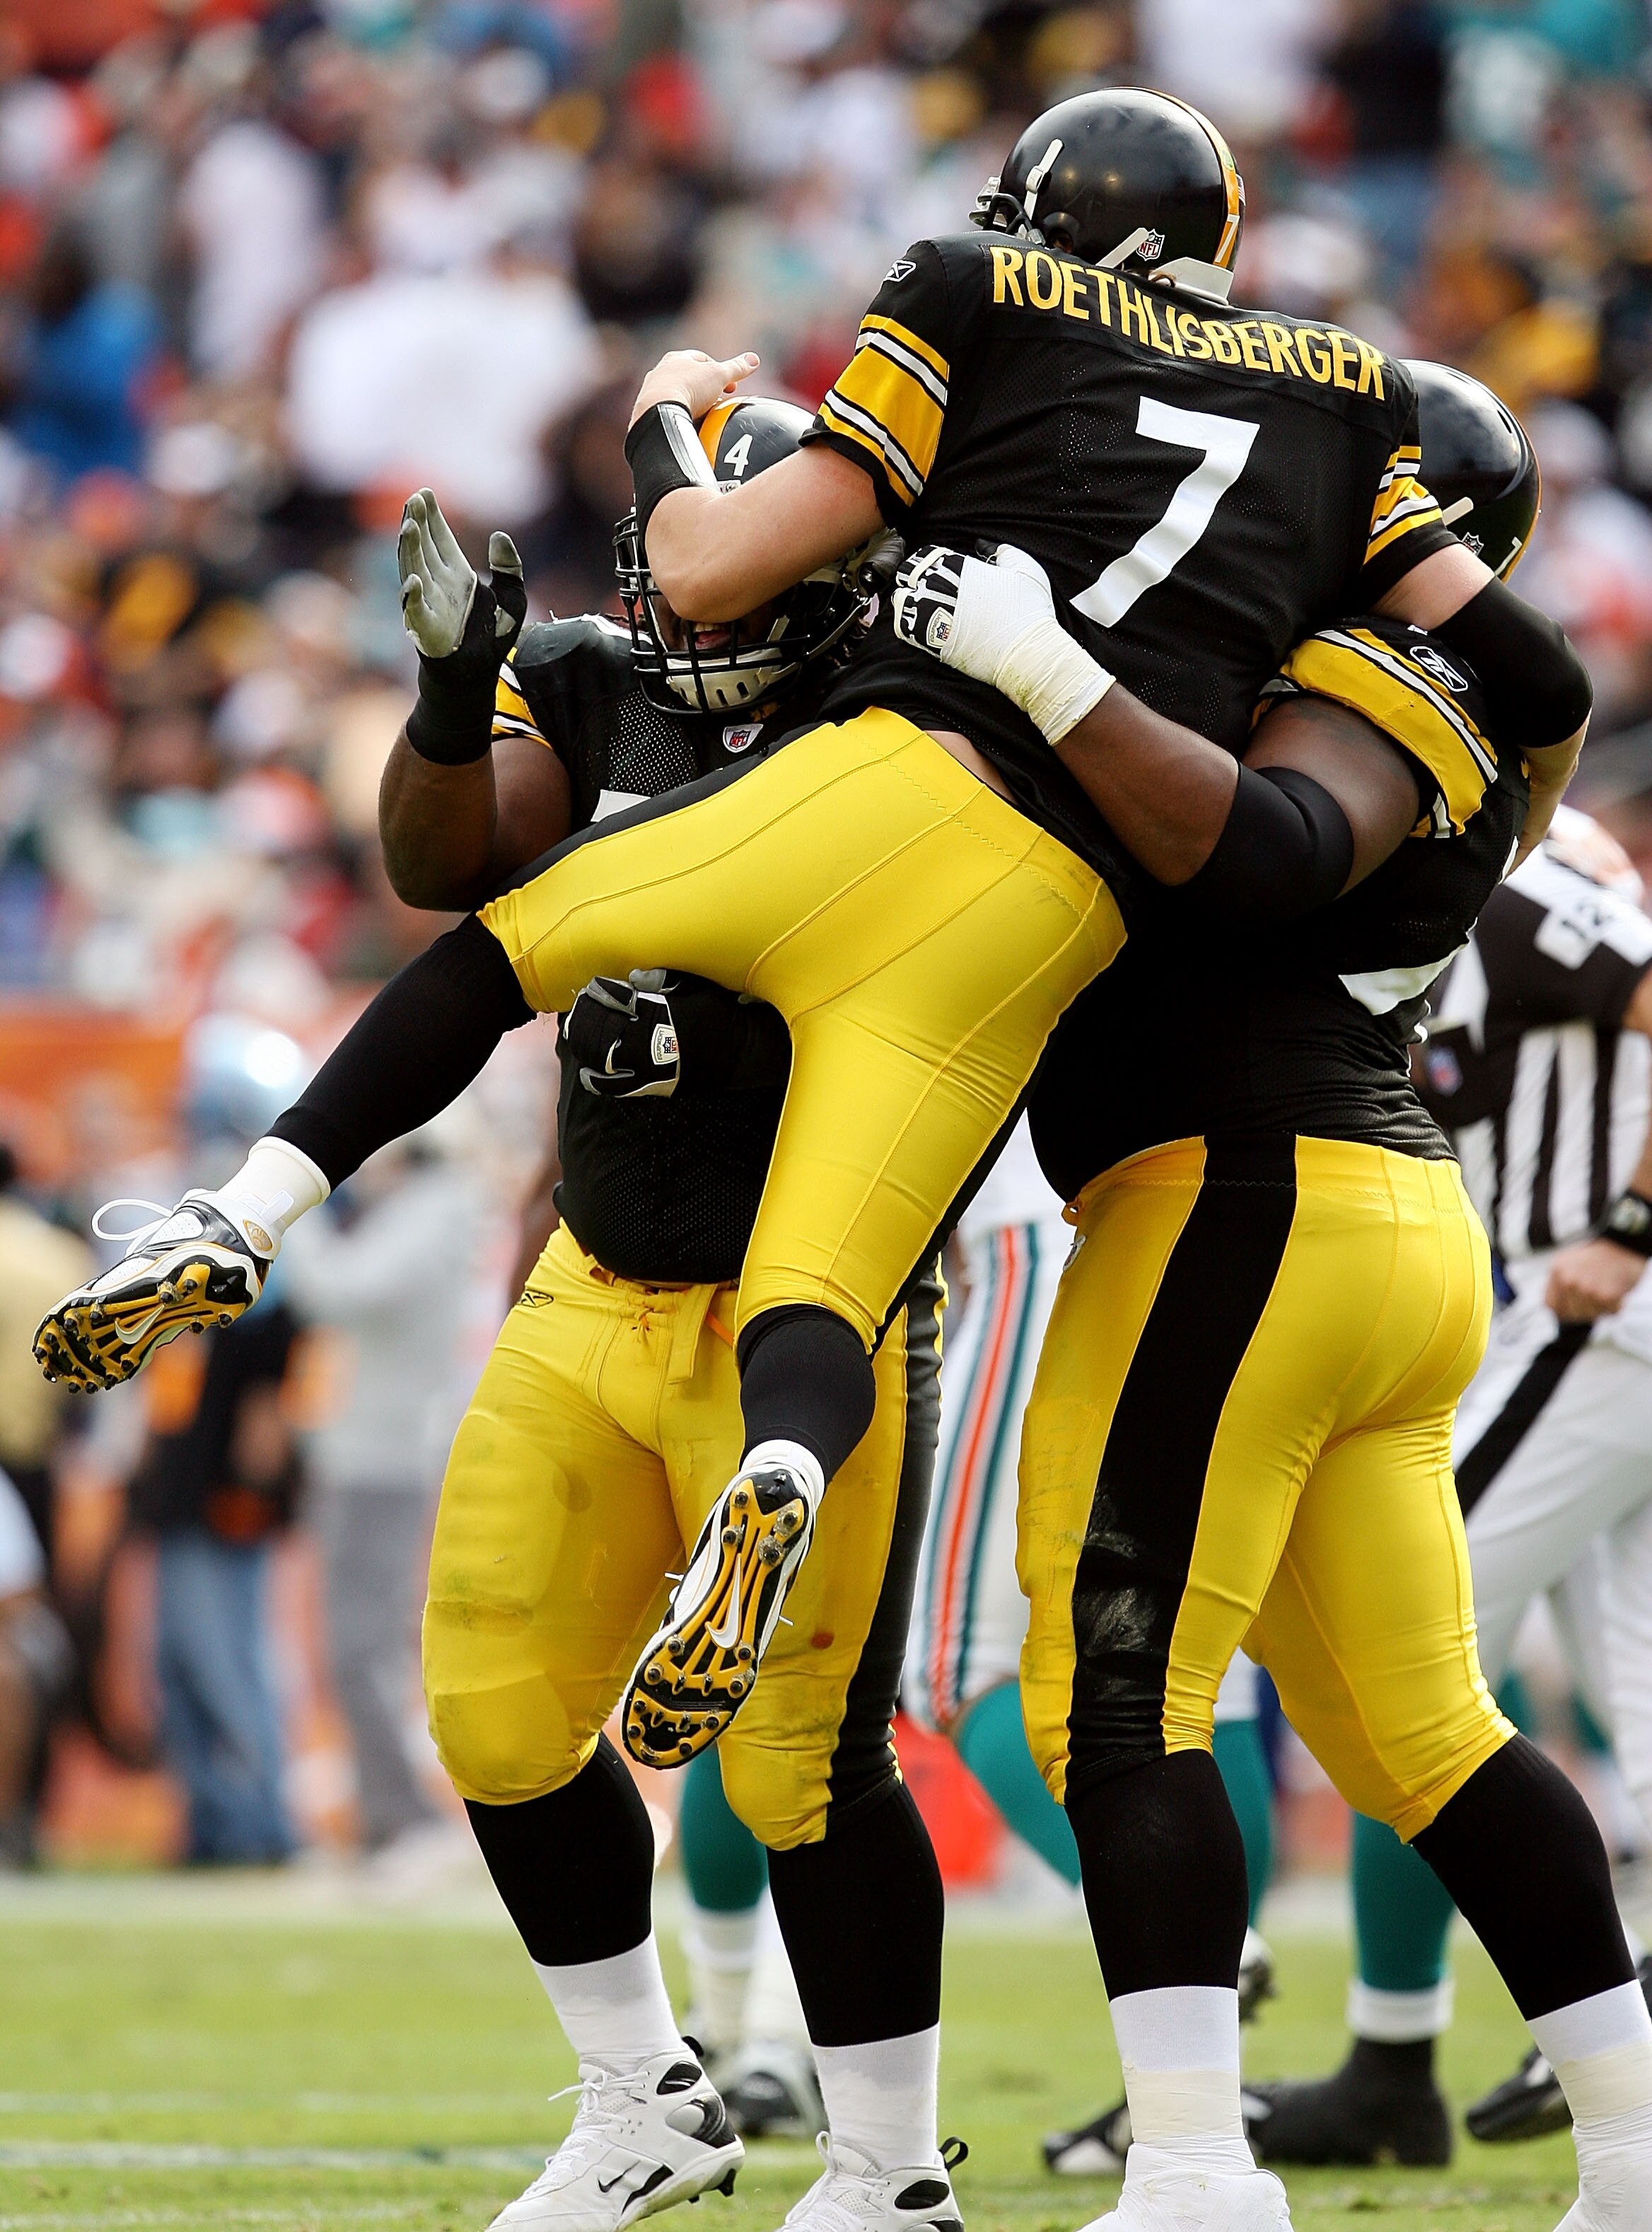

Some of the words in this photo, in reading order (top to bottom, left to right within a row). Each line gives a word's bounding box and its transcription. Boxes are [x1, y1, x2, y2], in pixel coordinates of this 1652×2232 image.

[1139, 241, 1158, 256] NFL
[1213, 214, 1240, 263] 7
[990, 247, 1385, 400] ROETHLISBERGER
[723, 434, 753, 477] 4
[1069, 396, 1260, 628] 7
